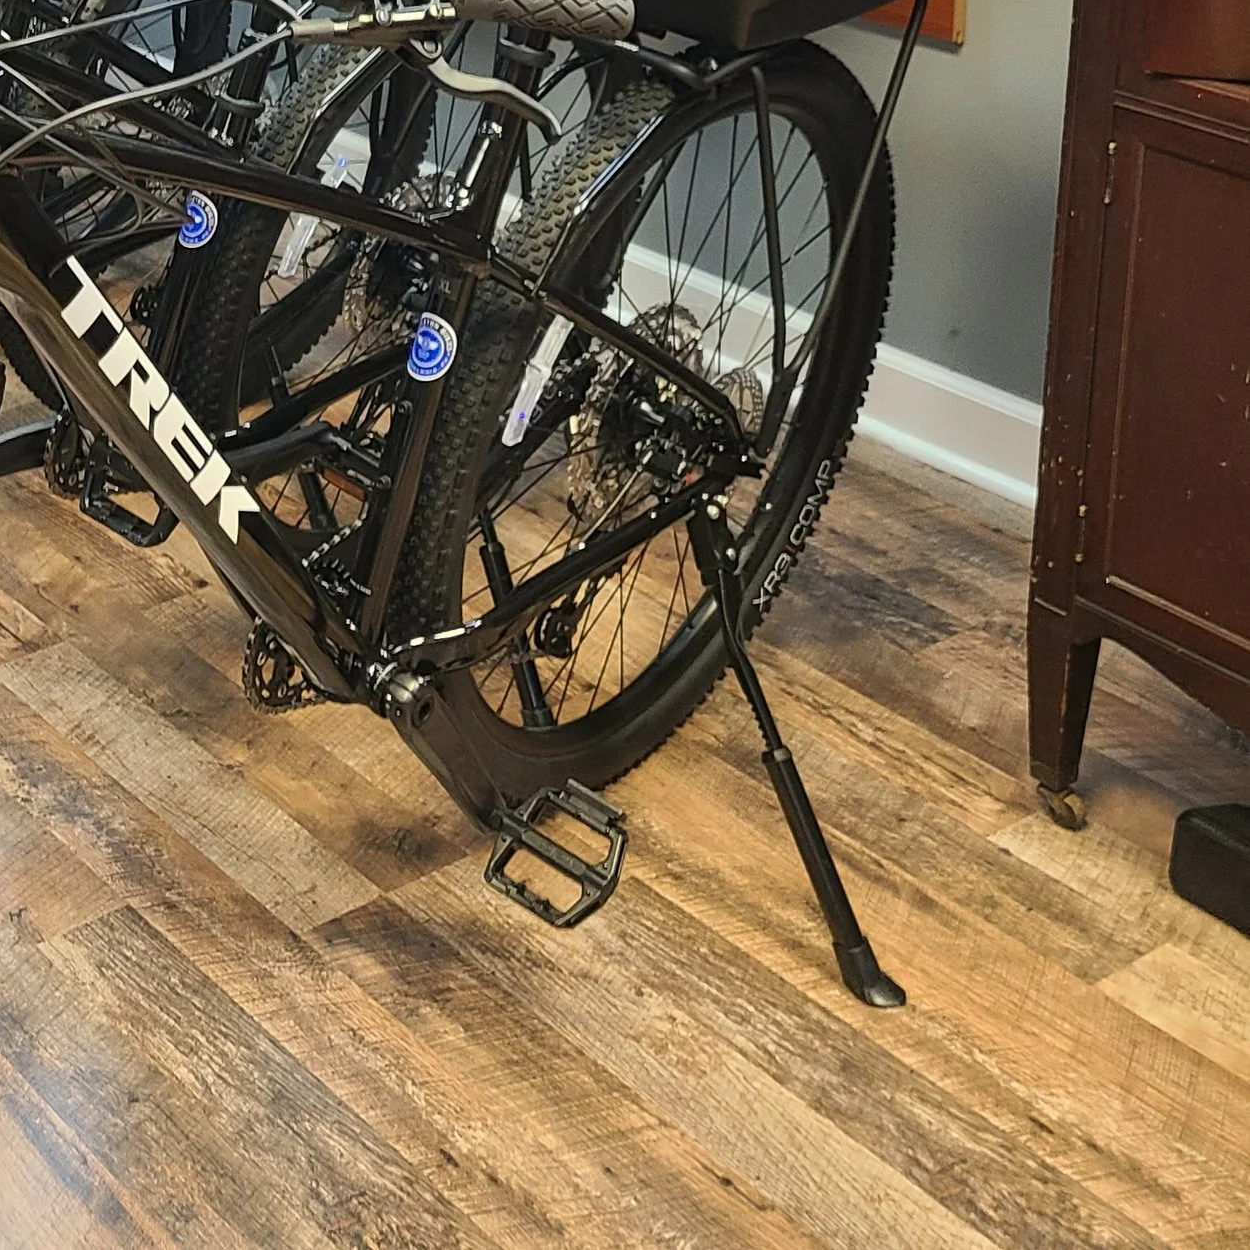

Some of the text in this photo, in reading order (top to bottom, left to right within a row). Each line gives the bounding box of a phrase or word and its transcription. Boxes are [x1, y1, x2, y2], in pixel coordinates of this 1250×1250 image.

[61, 254, 261, 546] TREK
[752, 459, 831, 612] XR3 COMP
